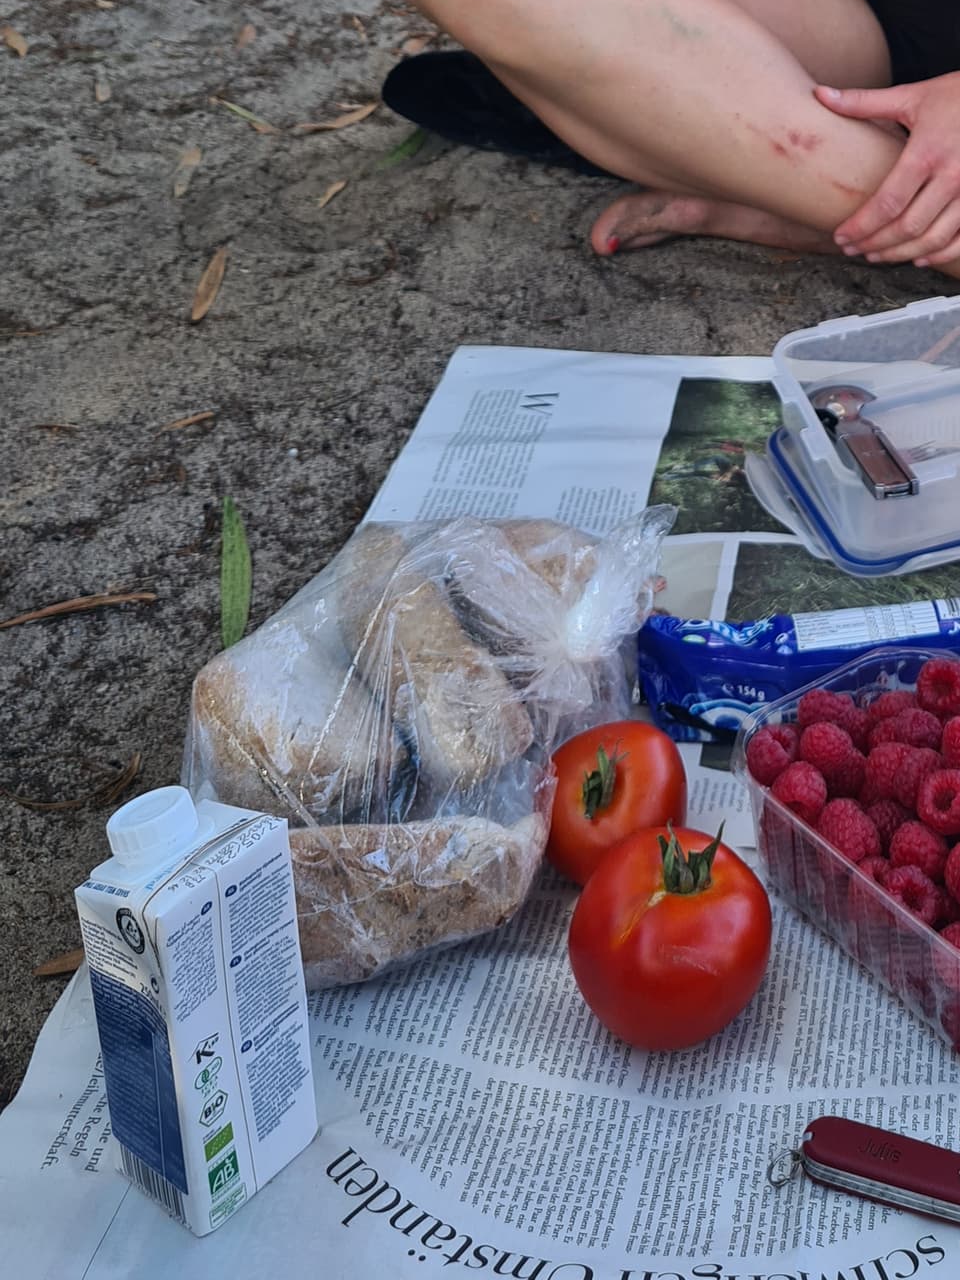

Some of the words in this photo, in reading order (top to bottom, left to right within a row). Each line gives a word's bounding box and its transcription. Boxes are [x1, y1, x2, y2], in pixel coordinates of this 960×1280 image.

[737, 684, 757, 698] 154
[756, 690, 766, 702] g
[203, 1093, 225, 1119] BIO
[68, 1114, 101, 1159] Regeln
[83, 1146, 106, 1174] und
[212, 1163, 235, 1193] AB
